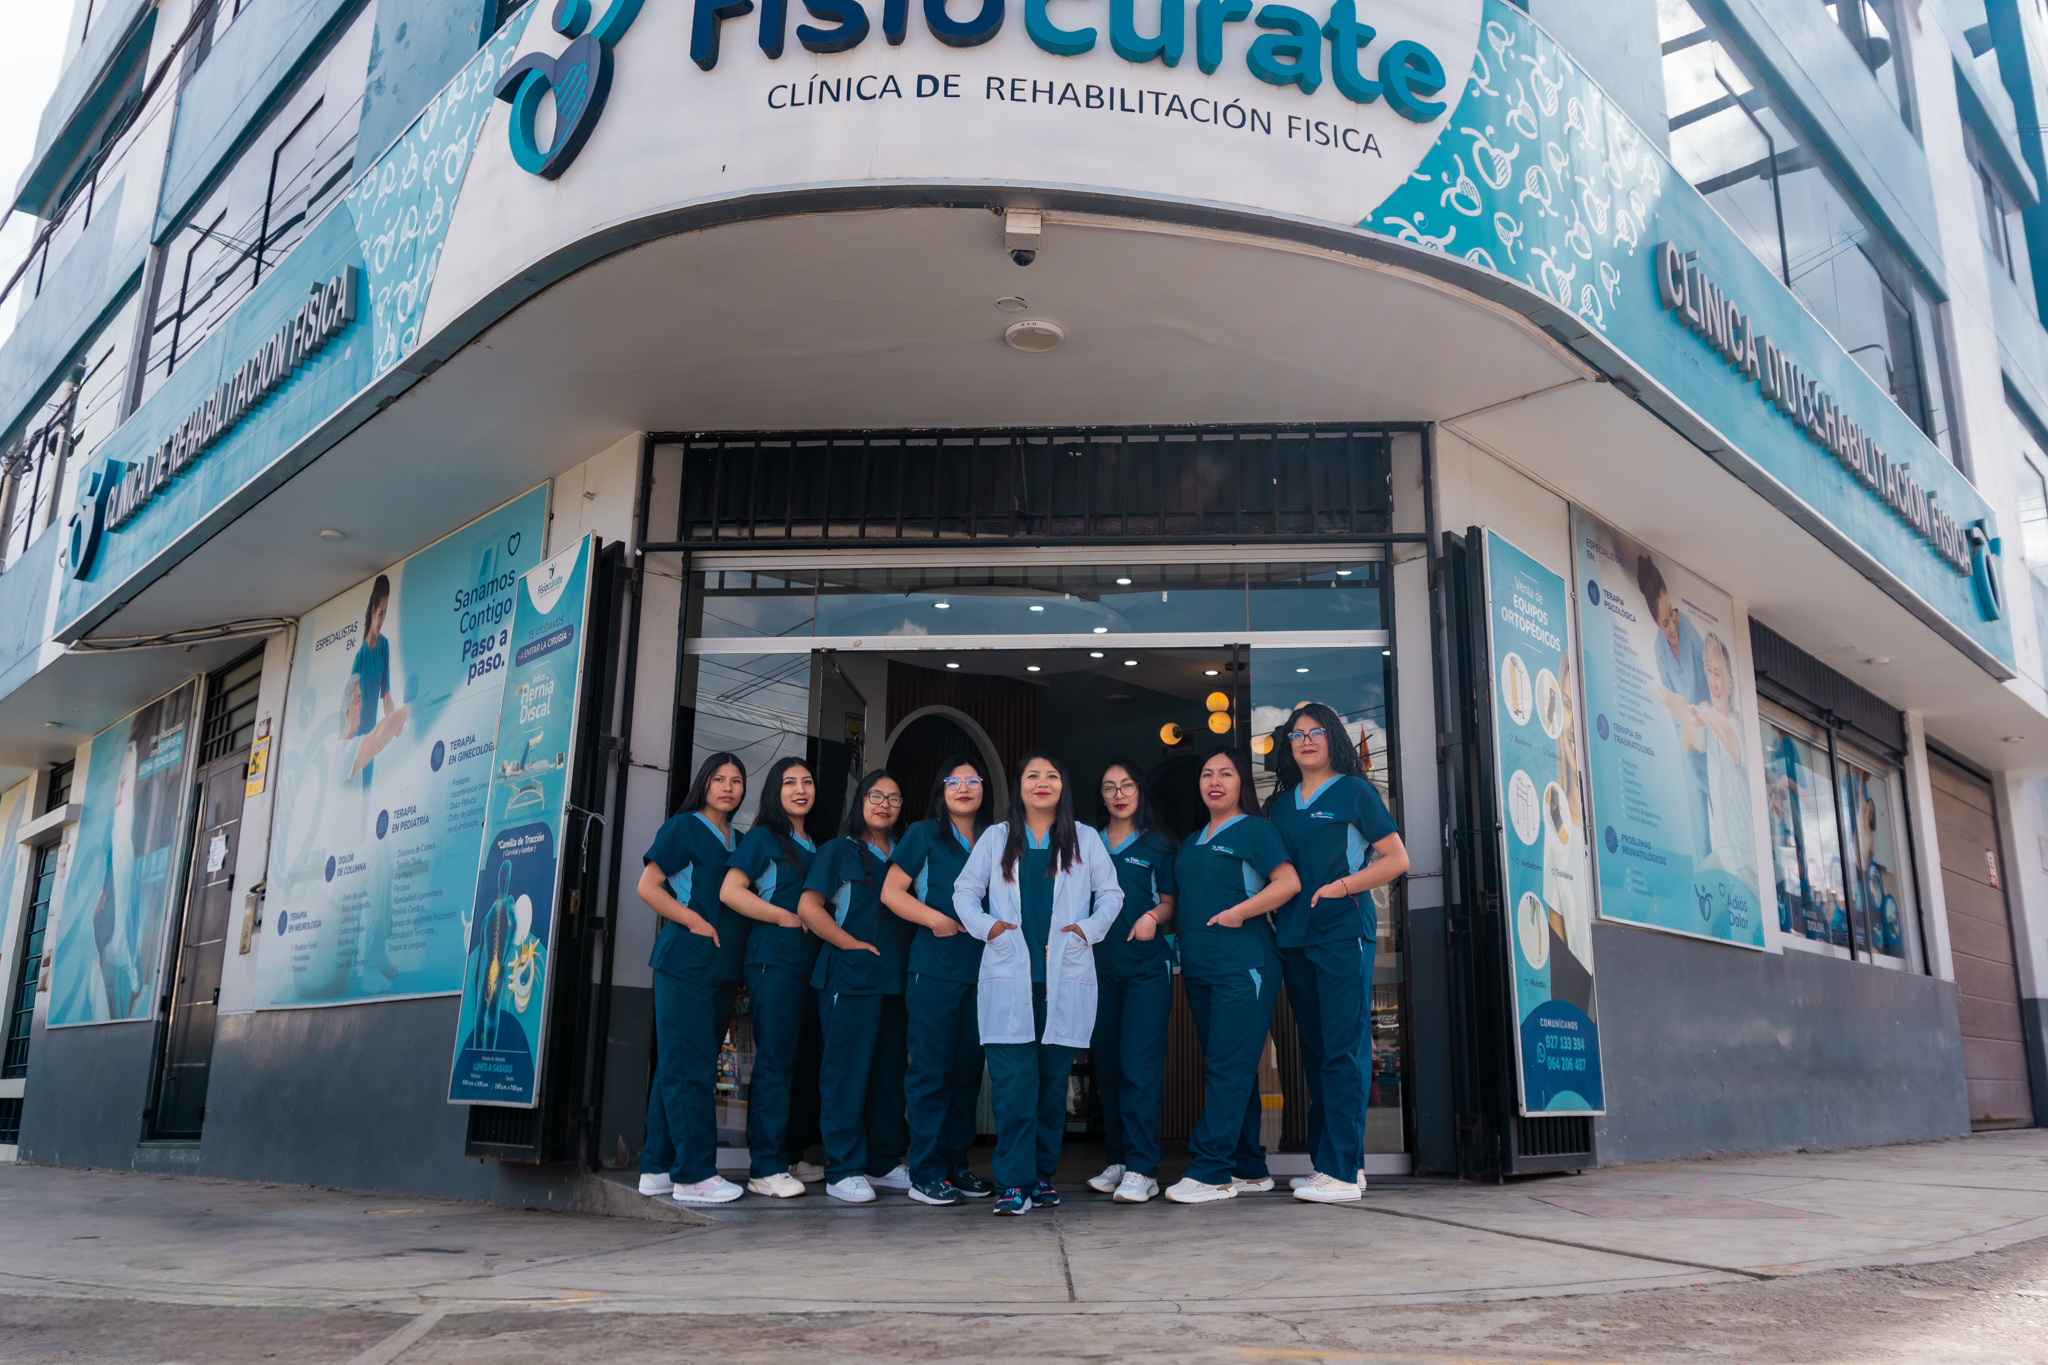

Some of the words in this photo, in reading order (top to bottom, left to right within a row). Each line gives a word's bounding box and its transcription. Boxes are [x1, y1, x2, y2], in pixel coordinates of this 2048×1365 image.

[767, 73, 902, 110] CLÍNICA
[916, 74, 961, 99] DE
[985, 75, 1272, 135] REHABILITACIÓN
[1287, 115, 1383, 159] FISICA
[1656, 240, 1761, 382] CLÍNICA
[1793, 365, 1931, 539] HABILITACIÓN
[149, 434, 173, 495] DE
[1586, 538, 1624, 566] ESPECIALISTAS
[454, 570, 516, 612] Sanamos
[1514, 576, 1534, 599] Venta
[1535, 590, 1544, 604] de
[1603, 588, 1624, 606] TERAPIA
[460, 598, 512, 634] Contigo
[1514, 594, 1548, 626] EQUIPOS
[1604, 600, 1637, 623] PSICOLÓGICA
[316, 620, 358, 652] ESPECIALISTAS
[528, 629, 536, 641] TE
[535, 614, 564, 638] AYUDAMOS
[1502, 606, 1561, 652] ORTOPÉDICOS
[346, 638, 356, 651] EN:
[462, 633, 495, 662] Paso
[500, 629, 508, 646] a
[524, 644, 540, 659] EVITAR
[540, 642, 547, 651] LA
[548, 630, 567, 649] CIRUGÍA
[468, 652, 505, 686] paso.
[532, 672, 546, 684] Adiós
[520, 676, 554, 705] Hernia
[520, 696, 550, 724] Discal
[1612, 722, 1634, 738] TERAPIA
[1635, 732, 1642, 741] EN
[450, 734, 476, 751] TERAPIA
[1613, 734, 1656, 757] TRAUMATOLOGÍA
[448, 754, 456, 765] EN
[458, 742, 494, 762] GINECOLOG
[478, 782, 490, 791] Urina
[394, 805, 416, 820] TERAPIA
[450, 802, 461, 810] Dolor
[392, 822, 400, 834] EN
[400, 812, 430, 831] PEDIATRÍA
[448, 813, 460, 822] Dolor
[518, 837, 524, 846] de
[525, 832, 544, 844] Tracción
[1622, 834, 1652, 850] PROBLEMAS
[338, 853, 354, 864] DOLOR
[1622, 846, 1667, 866] REUMATOLÓGICOS
[337, 868, 344, 877] DE
[344, 862, 366, 876] COLUMNA
[1728, 893, 1748, 912] Adiós
[288, 925, 294, 933] EN
[295, 918, 322, 932] NEUROLOGÍA
[290, 911, 308, 921] TERAPIA
[1729, 910, 1749, 930] Dolor
[1530, 979, 1546, 988] Muletas
[1540, 1018, 1578, 1030] COMUNÍCANOS
[1546, 1035, 1558, 1049] 927
[1560, 1036, 1572, 1050] 133
[1573, 1038, 1585, 1051] 394
[473, 1062, 488, 1072] LUNES
[488, 1064, 492, 1072] A
[492, 1060, 513, 1074] SÁBADO
[1548, 1056, 1560, 1070] 064
[1562, 1057, 1574, 1070] 206
[1574, 1058, 1586, 1072] 487
